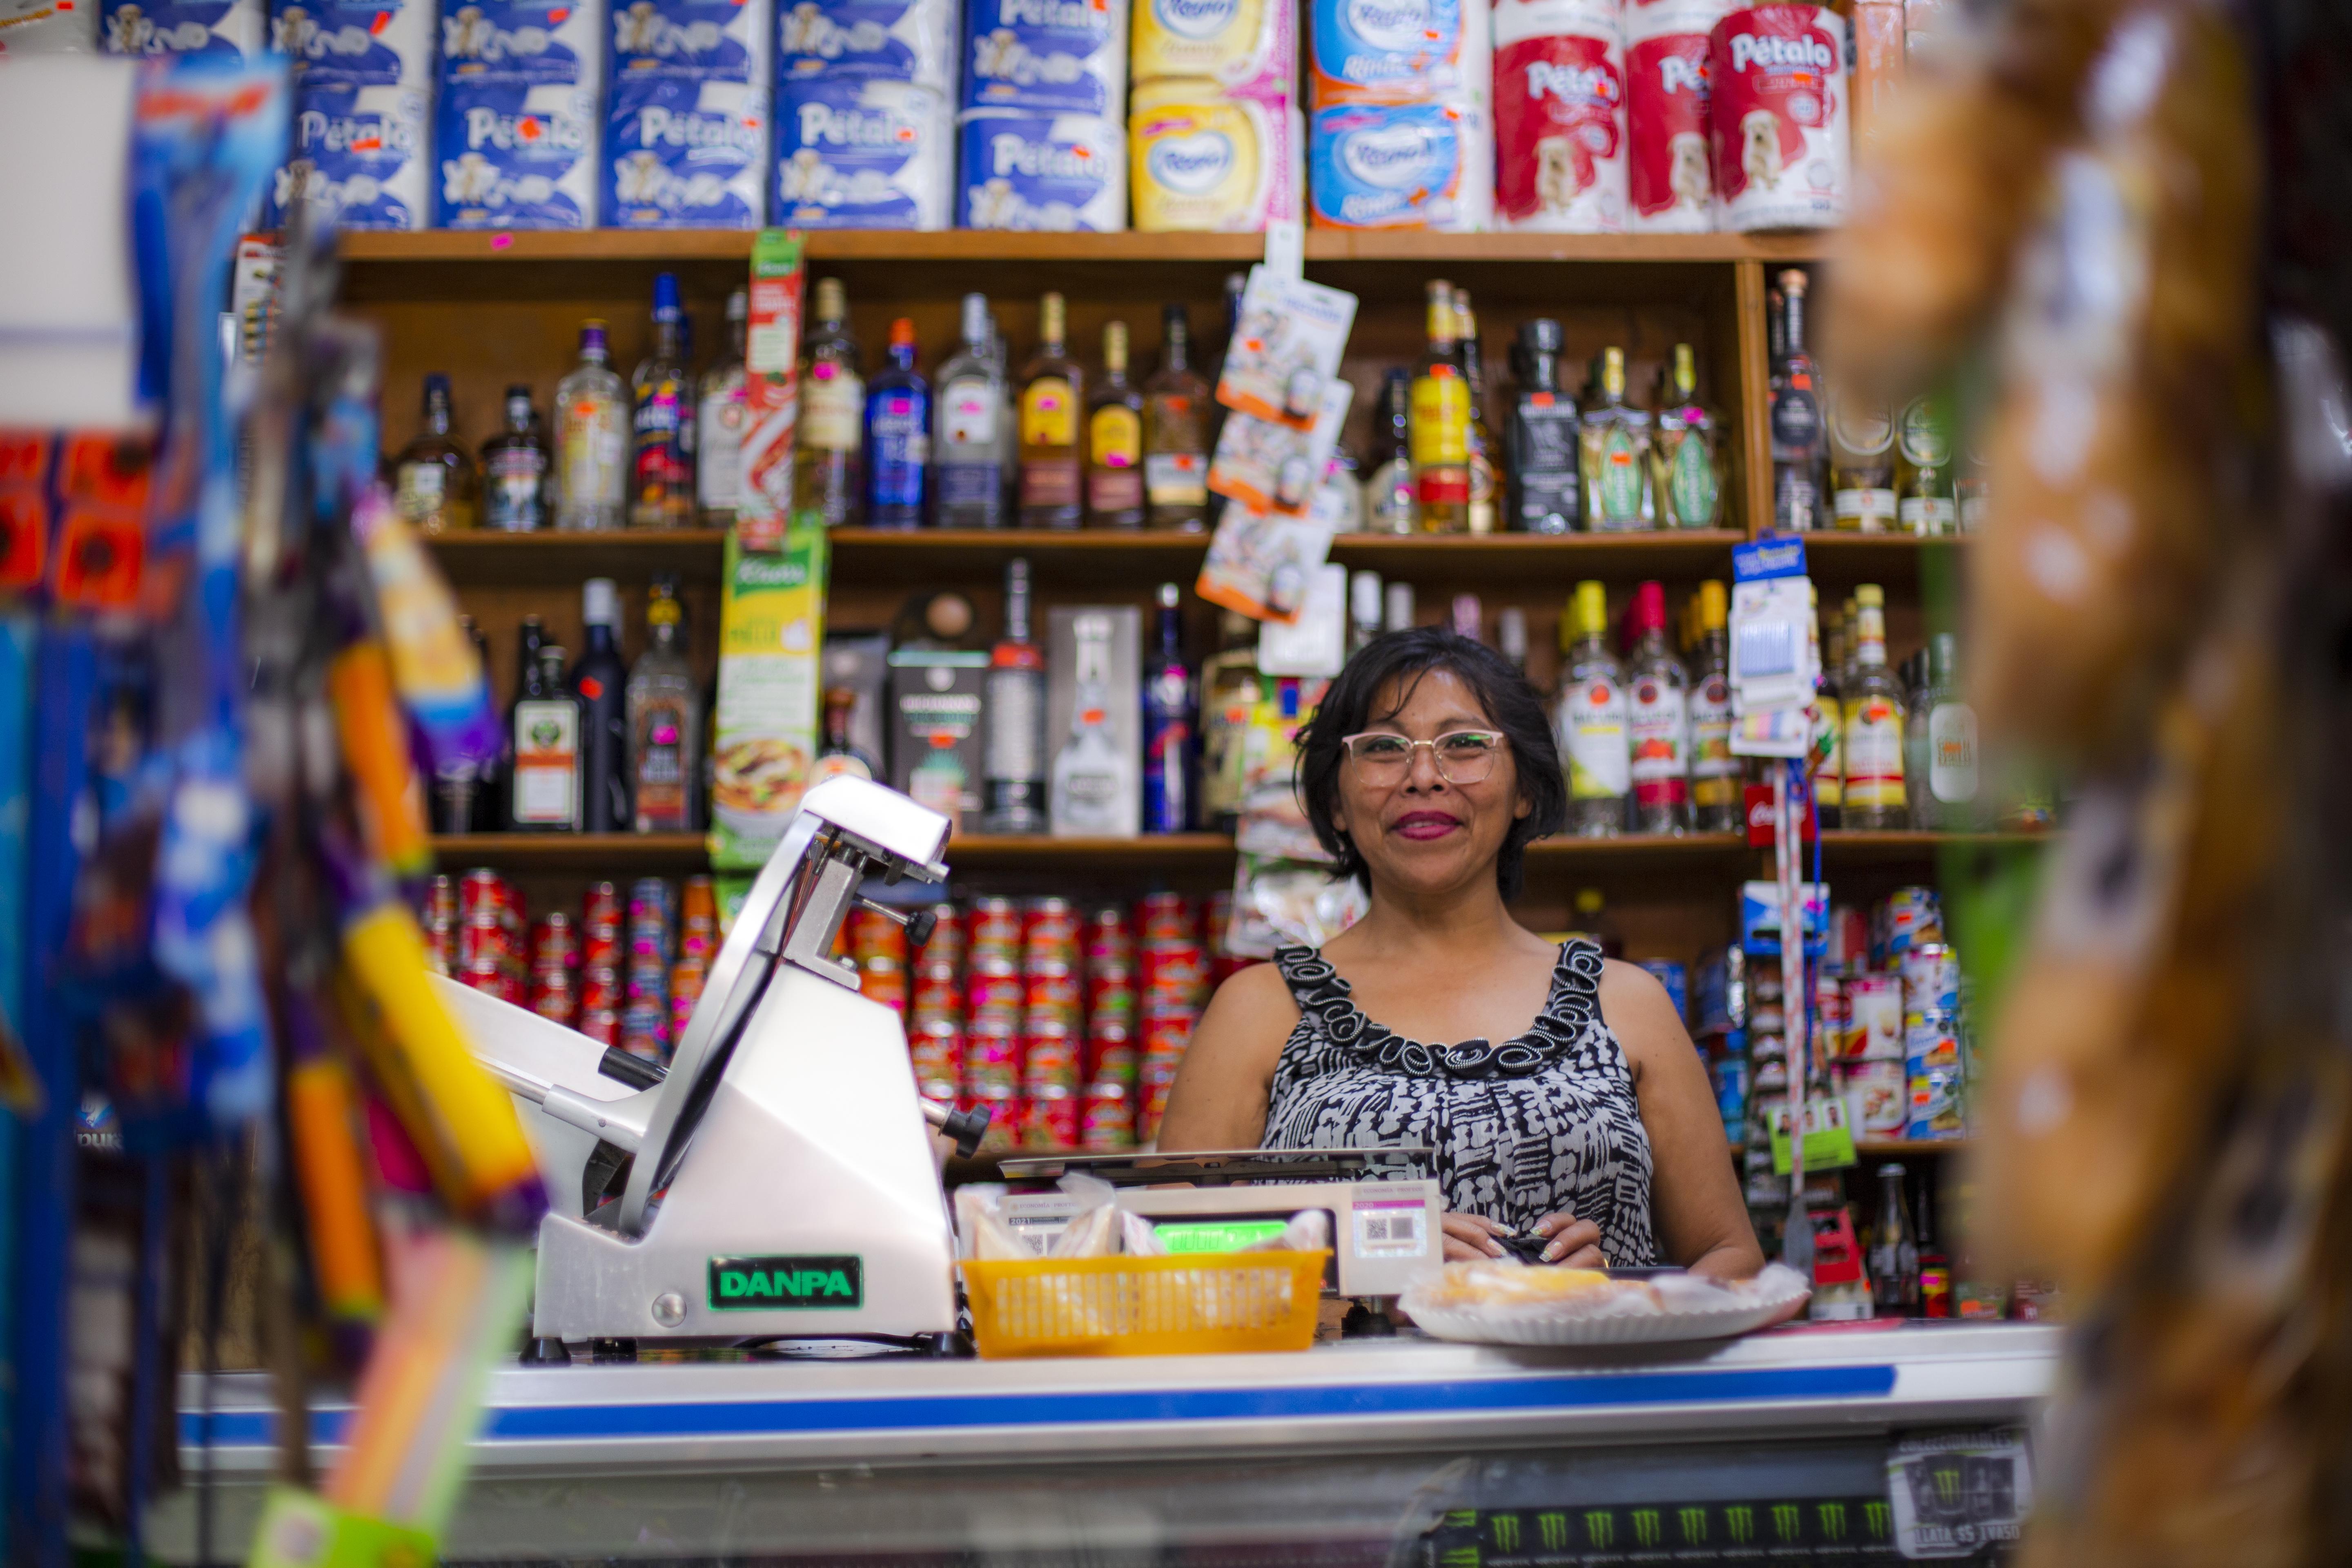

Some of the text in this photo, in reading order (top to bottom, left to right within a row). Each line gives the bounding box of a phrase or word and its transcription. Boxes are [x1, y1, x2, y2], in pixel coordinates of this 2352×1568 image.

[1729, 33, 1831, 73] Pétalo
[465, 107, 583, 150] Péalo
[720, 1270, 852, 1297] DANPA
